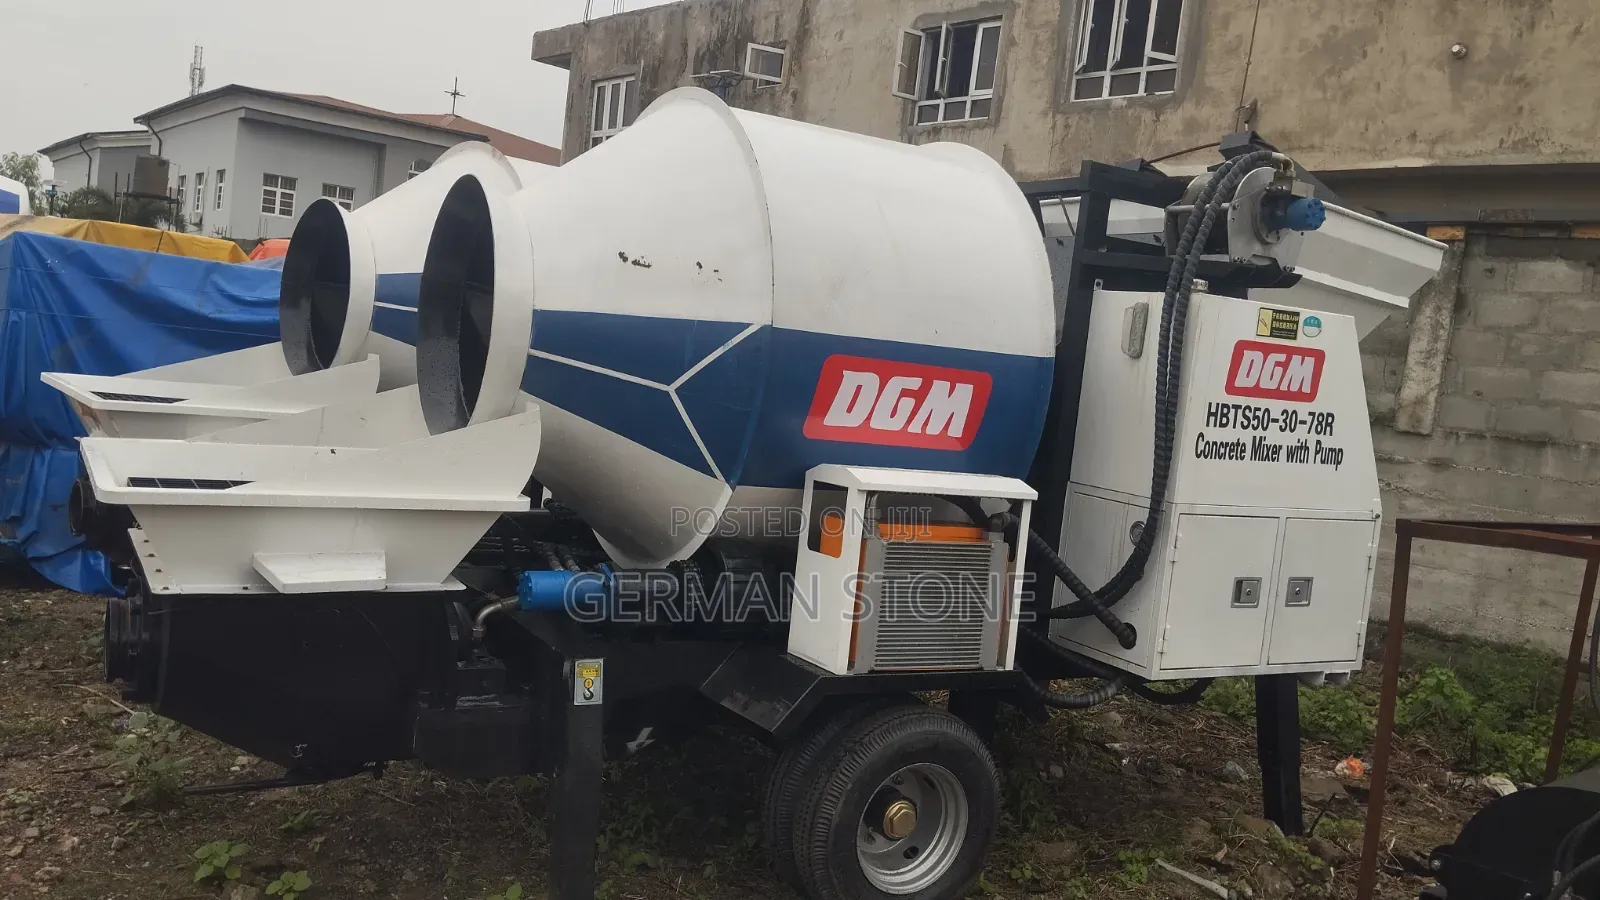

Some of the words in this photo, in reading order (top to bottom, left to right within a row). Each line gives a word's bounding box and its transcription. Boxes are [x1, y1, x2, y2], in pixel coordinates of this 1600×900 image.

[1234, 349, 1315, 394] DGM
[823, 369, 974, 438] DGM
[1205, 401, 1336, 437] HBTS50-30-78R
[1194, 431, 1247, 461] Concrete
[1249, 435, 1283, 463] Mixer
[1285, 438, 1311, 464] with
[1313, 439, 1344, 472] Pump
